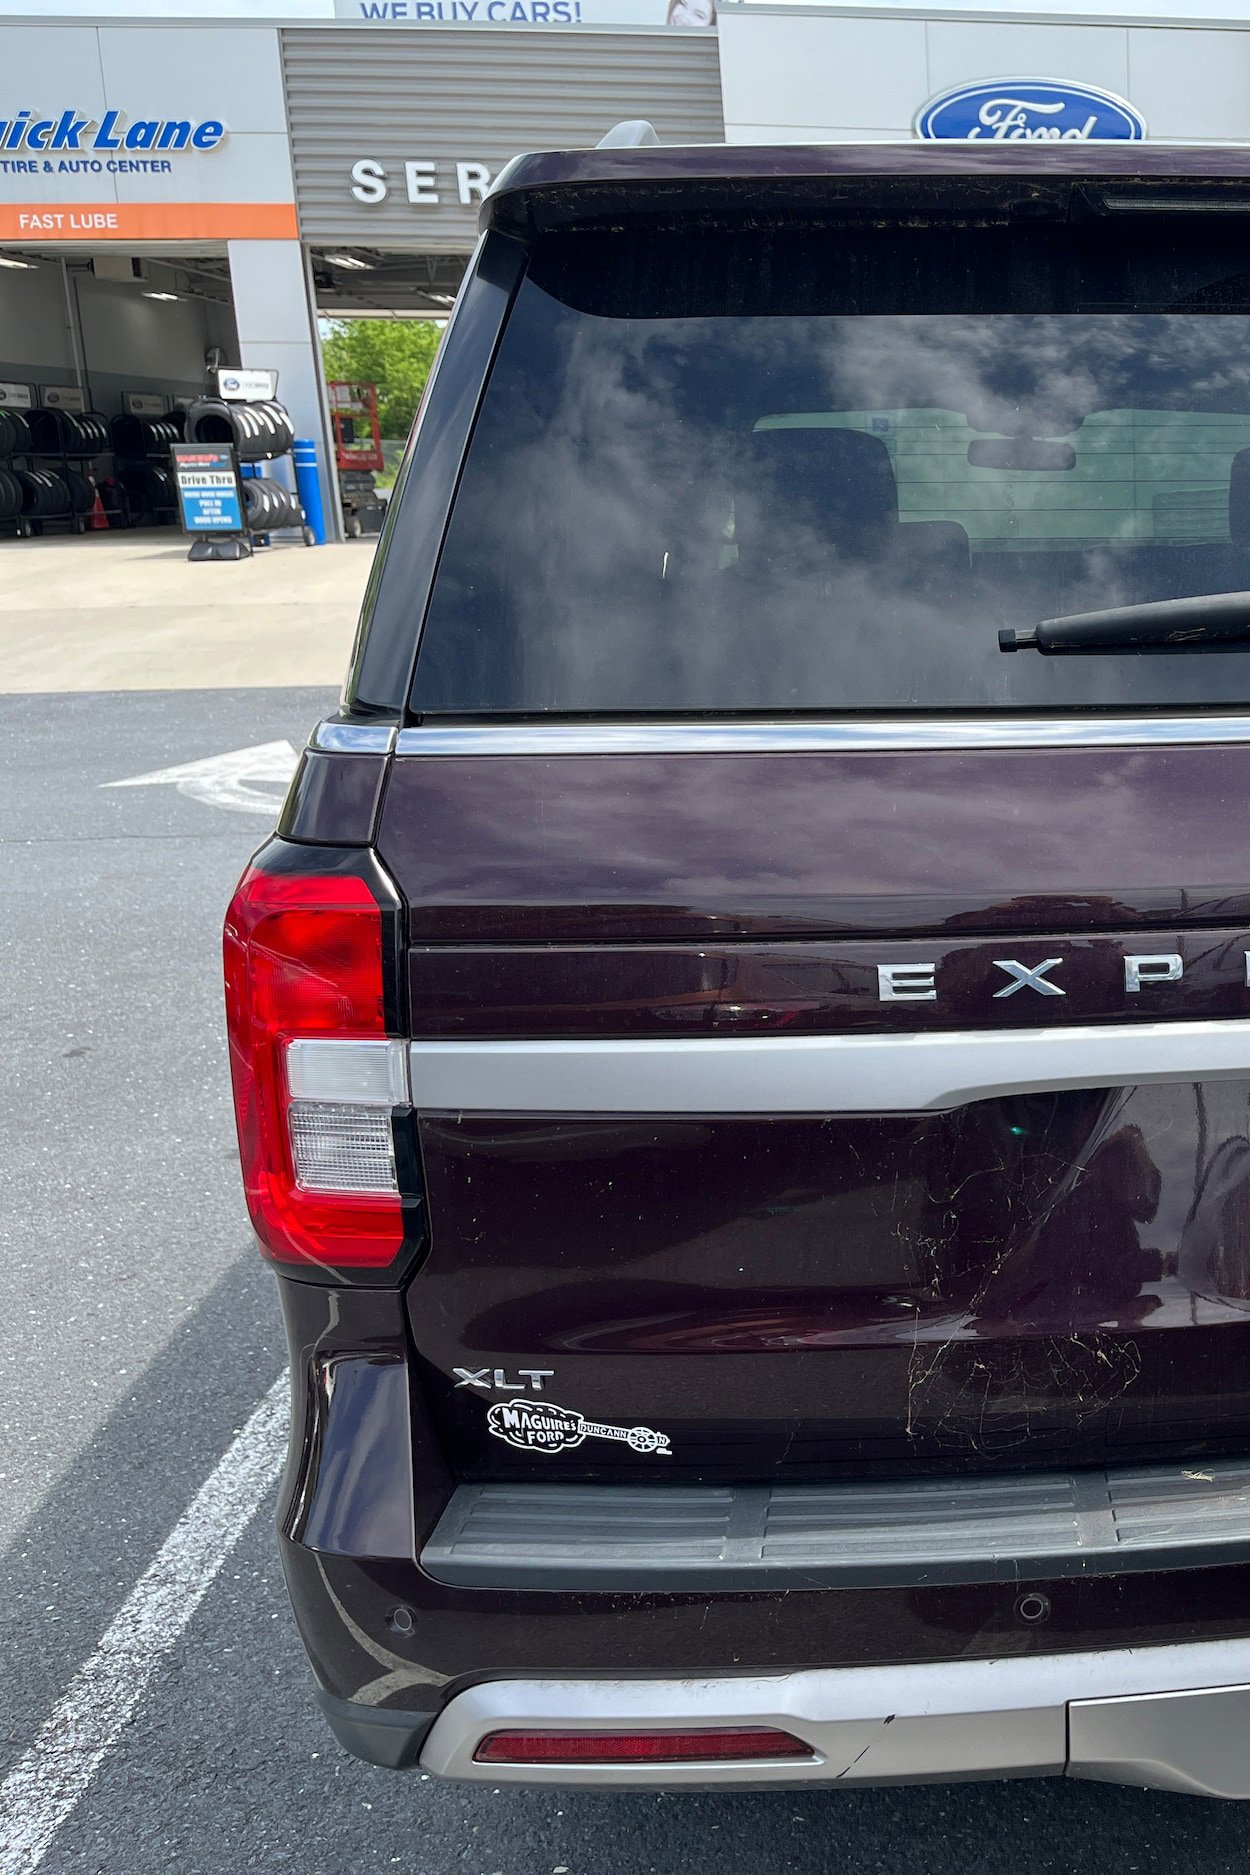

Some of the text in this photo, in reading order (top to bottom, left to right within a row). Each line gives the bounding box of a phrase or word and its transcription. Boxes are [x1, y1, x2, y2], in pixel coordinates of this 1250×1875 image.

[416, 2, 479, 21] BUY
[487, 1, 583, 23] CARS!
[93, 110, 225, 150] Lane
[1, 160, 172, 173] TIRE & AUTO CENTER
[19, 214, 119, 230] FAST LUBE
[181, 475, 233, 485] Drive Thru
[452, 1367, 555, 1392] XLT
[527, 1430, 565, 1445] FORD
